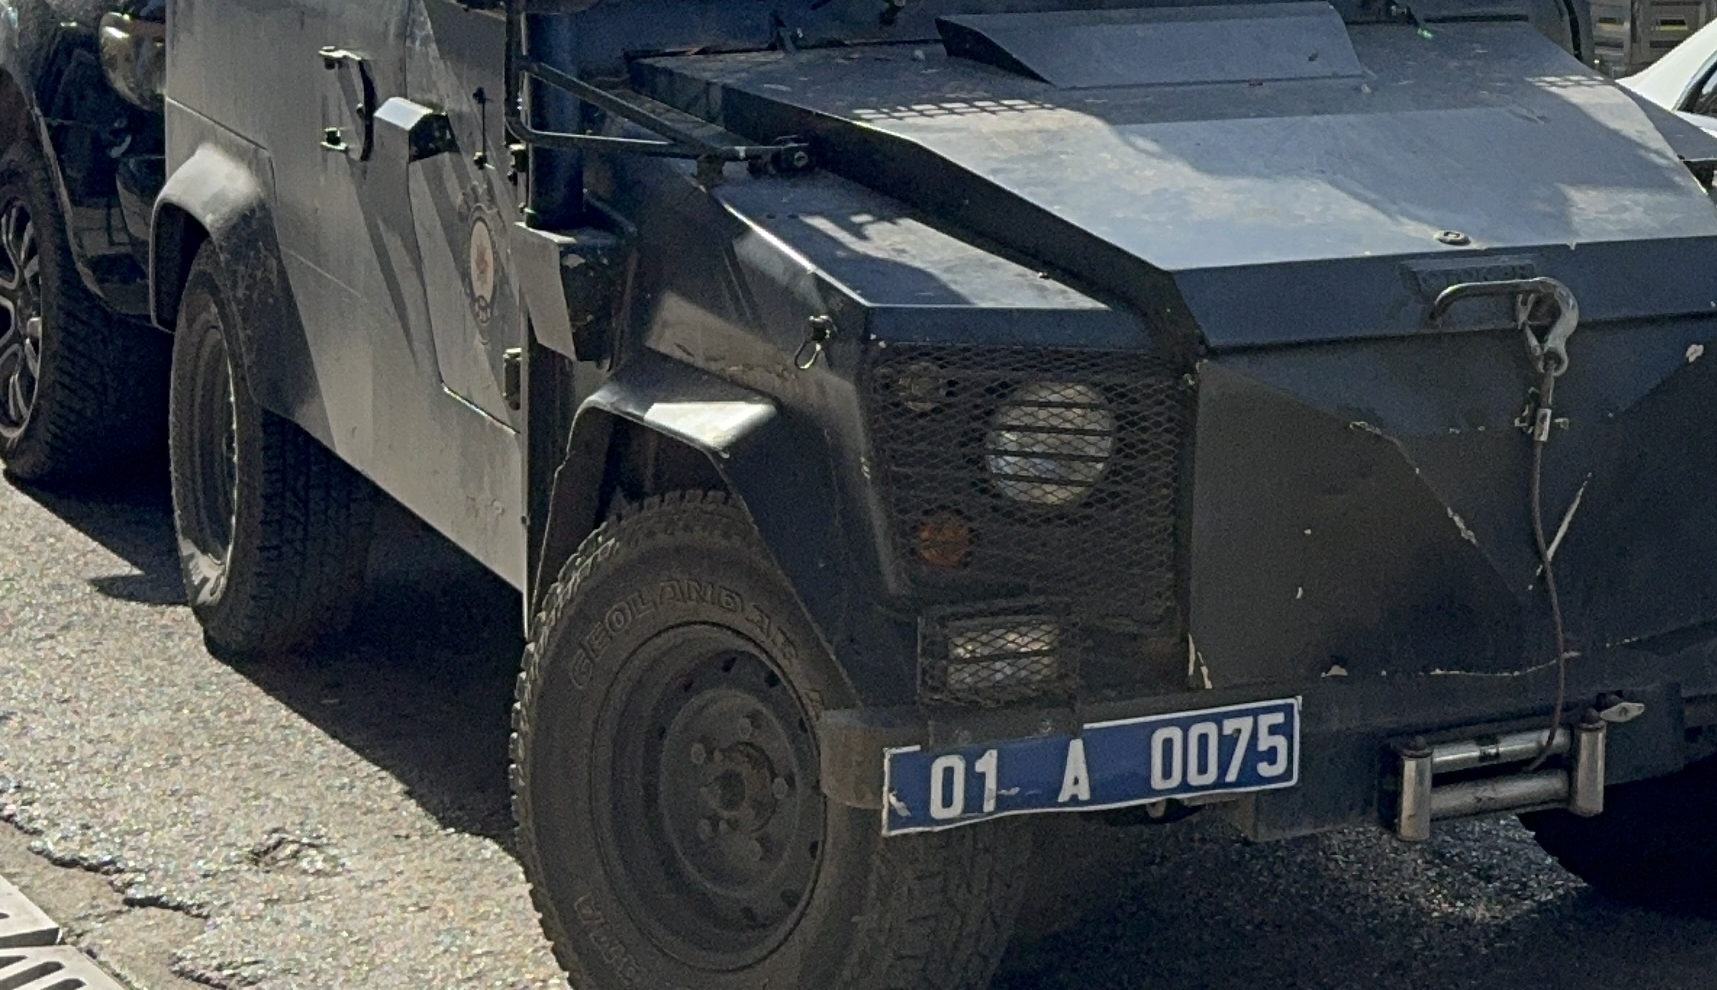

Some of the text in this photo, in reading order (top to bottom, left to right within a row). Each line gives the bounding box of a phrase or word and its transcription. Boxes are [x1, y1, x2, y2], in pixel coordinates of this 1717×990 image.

[929, 711, 1289, 820] 01 A 0075
